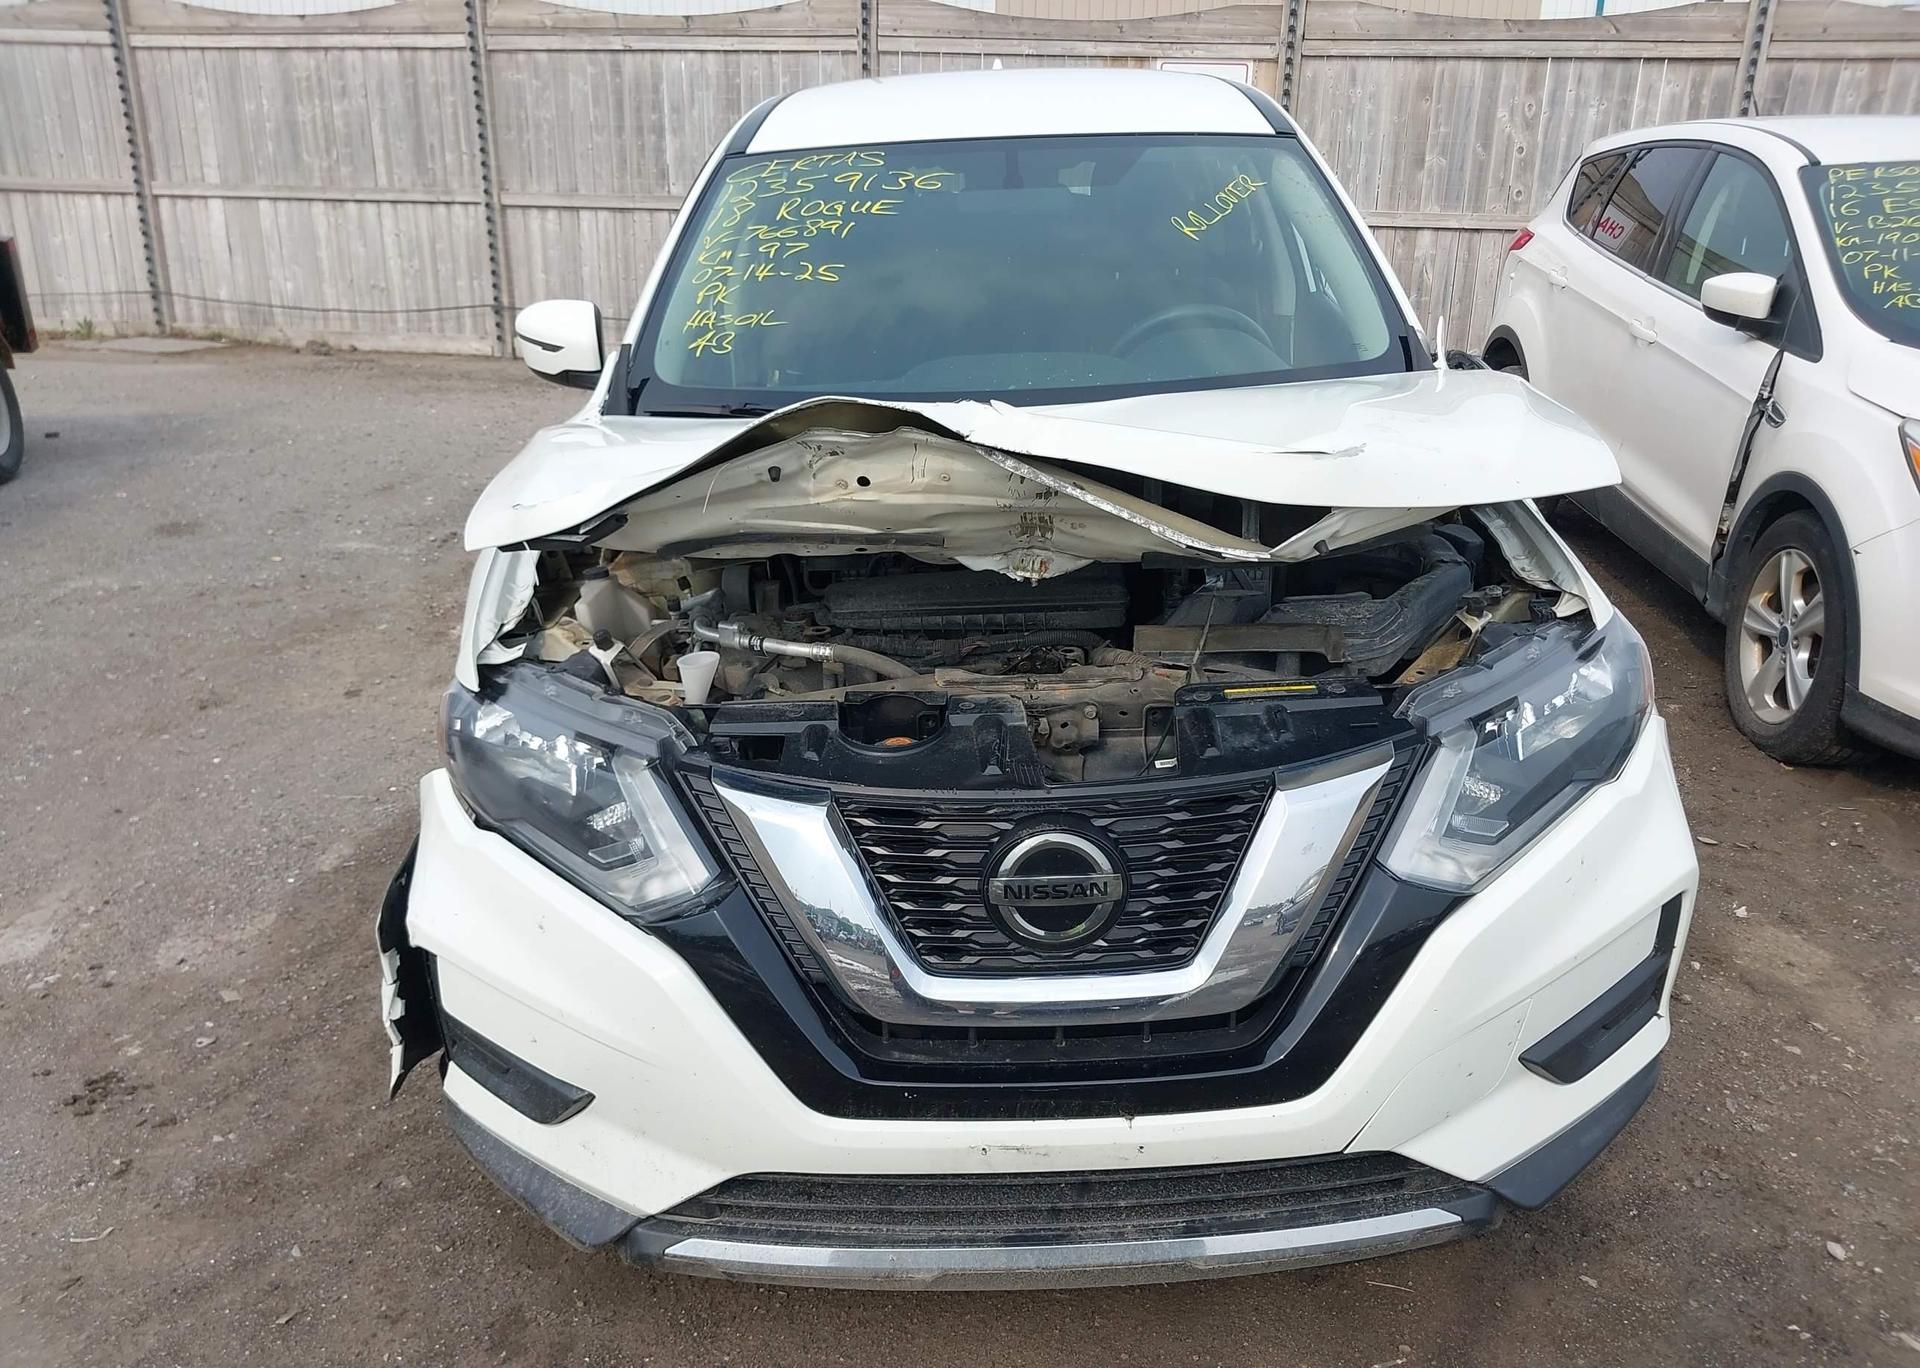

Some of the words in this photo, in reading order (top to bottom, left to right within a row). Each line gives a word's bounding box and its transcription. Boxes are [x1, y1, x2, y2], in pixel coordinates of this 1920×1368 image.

[1828, 166, 1920, 184] PERSO
[776, 198, 904, 221] ROGUE
[1829, 200, 1860, 218] 16
[1864, 263, 1902, 279] PK
[697, 282, 740, 306] PK
[1003, 881, 1108, 900] NISSAN
